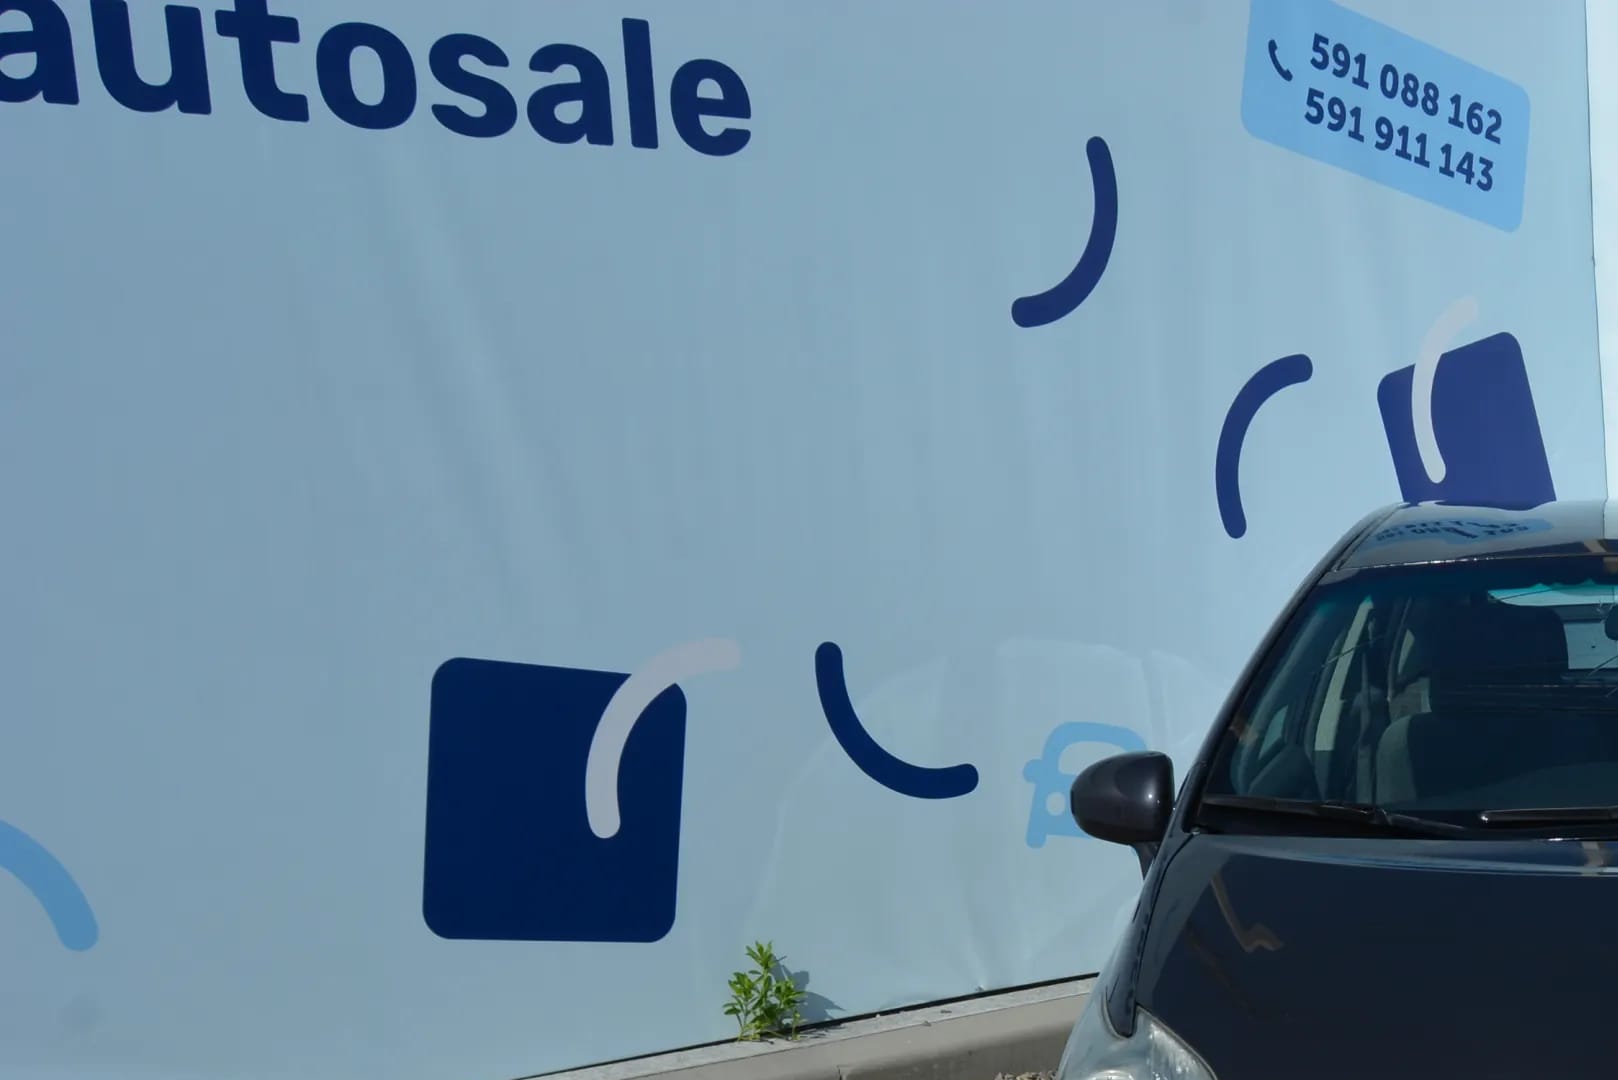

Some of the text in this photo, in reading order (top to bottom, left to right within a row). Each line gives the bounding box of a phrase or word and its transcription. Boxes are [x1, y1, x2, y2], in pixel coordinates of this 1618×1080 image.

[0, 0, 751, 156] autosale
[1310, 32, 1502, 144] 591 088 162
[1305, 87, 1494, 192] 591 911 143
